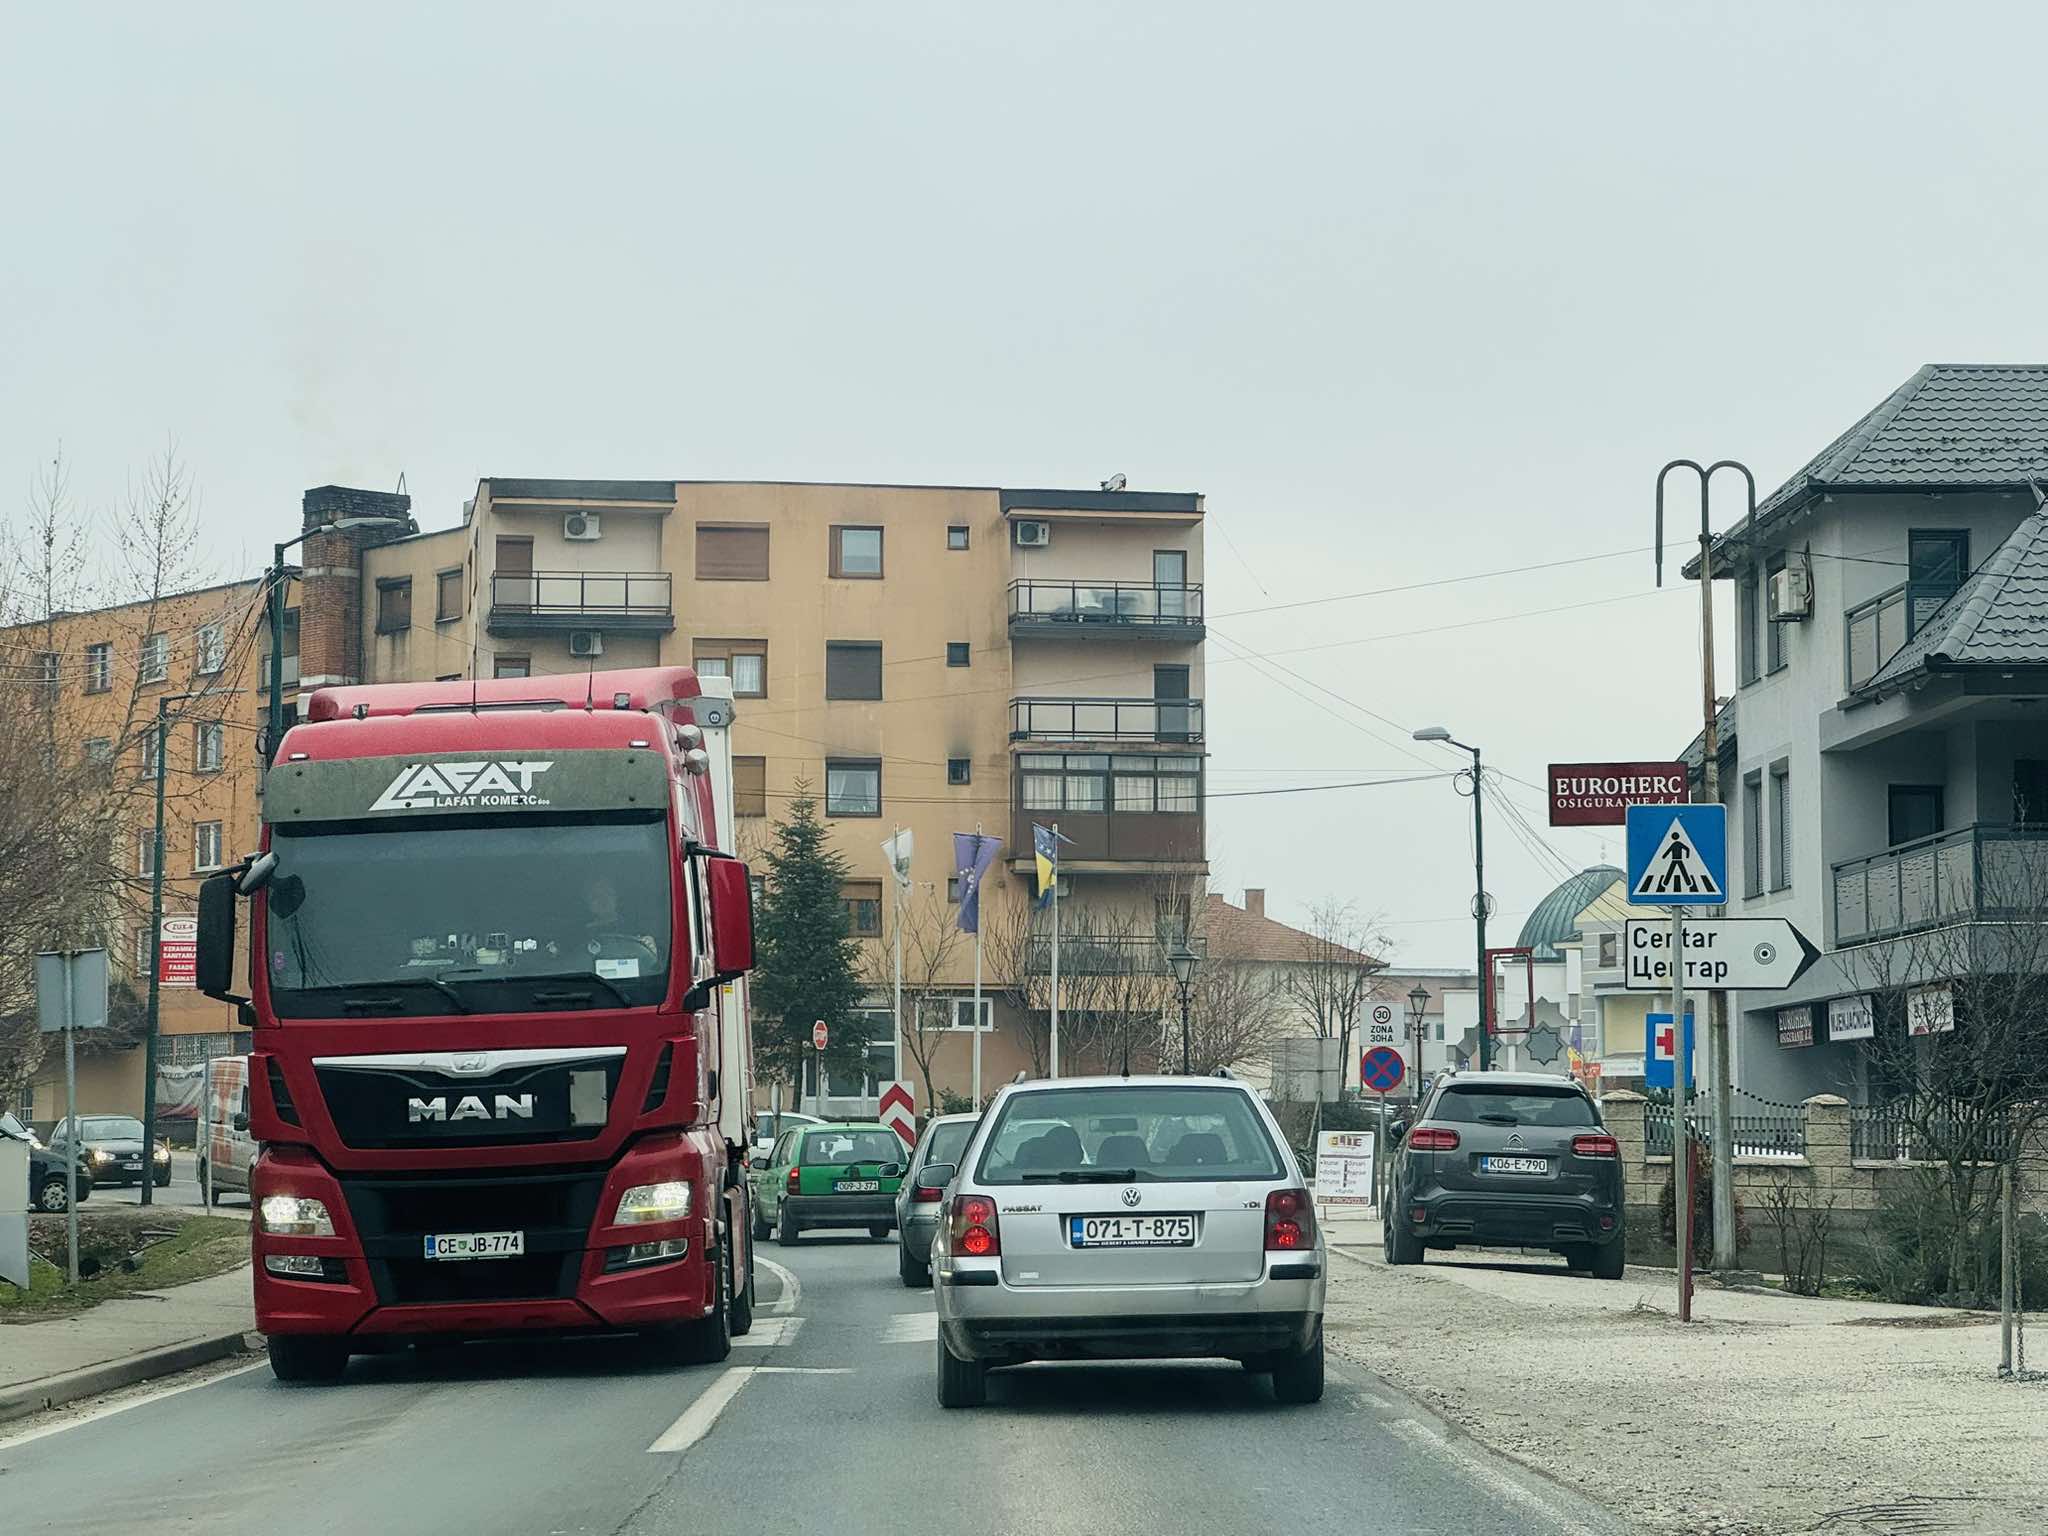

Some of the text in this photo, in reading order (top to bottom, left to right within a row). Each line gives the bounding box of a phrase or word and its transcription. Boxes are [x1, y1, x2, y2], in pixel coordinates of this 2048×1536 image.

[1555, 776, 1682, 796] EUROHERC
[436, 796, 477, 808] LAFAT
[480, 795, 538, 806] KOMERC
[1376, 1011, 1388, 1019] 30
[1370, 1025, 1394, 1033] ZONA
[1370, 1034, 1394, 1042] ЗОНА
[409, 1094, 533, 1122] MAN
[1086, 1219, 1190, 1238] 071-T-875
[469, 1236, 519, 1251] JB-774
